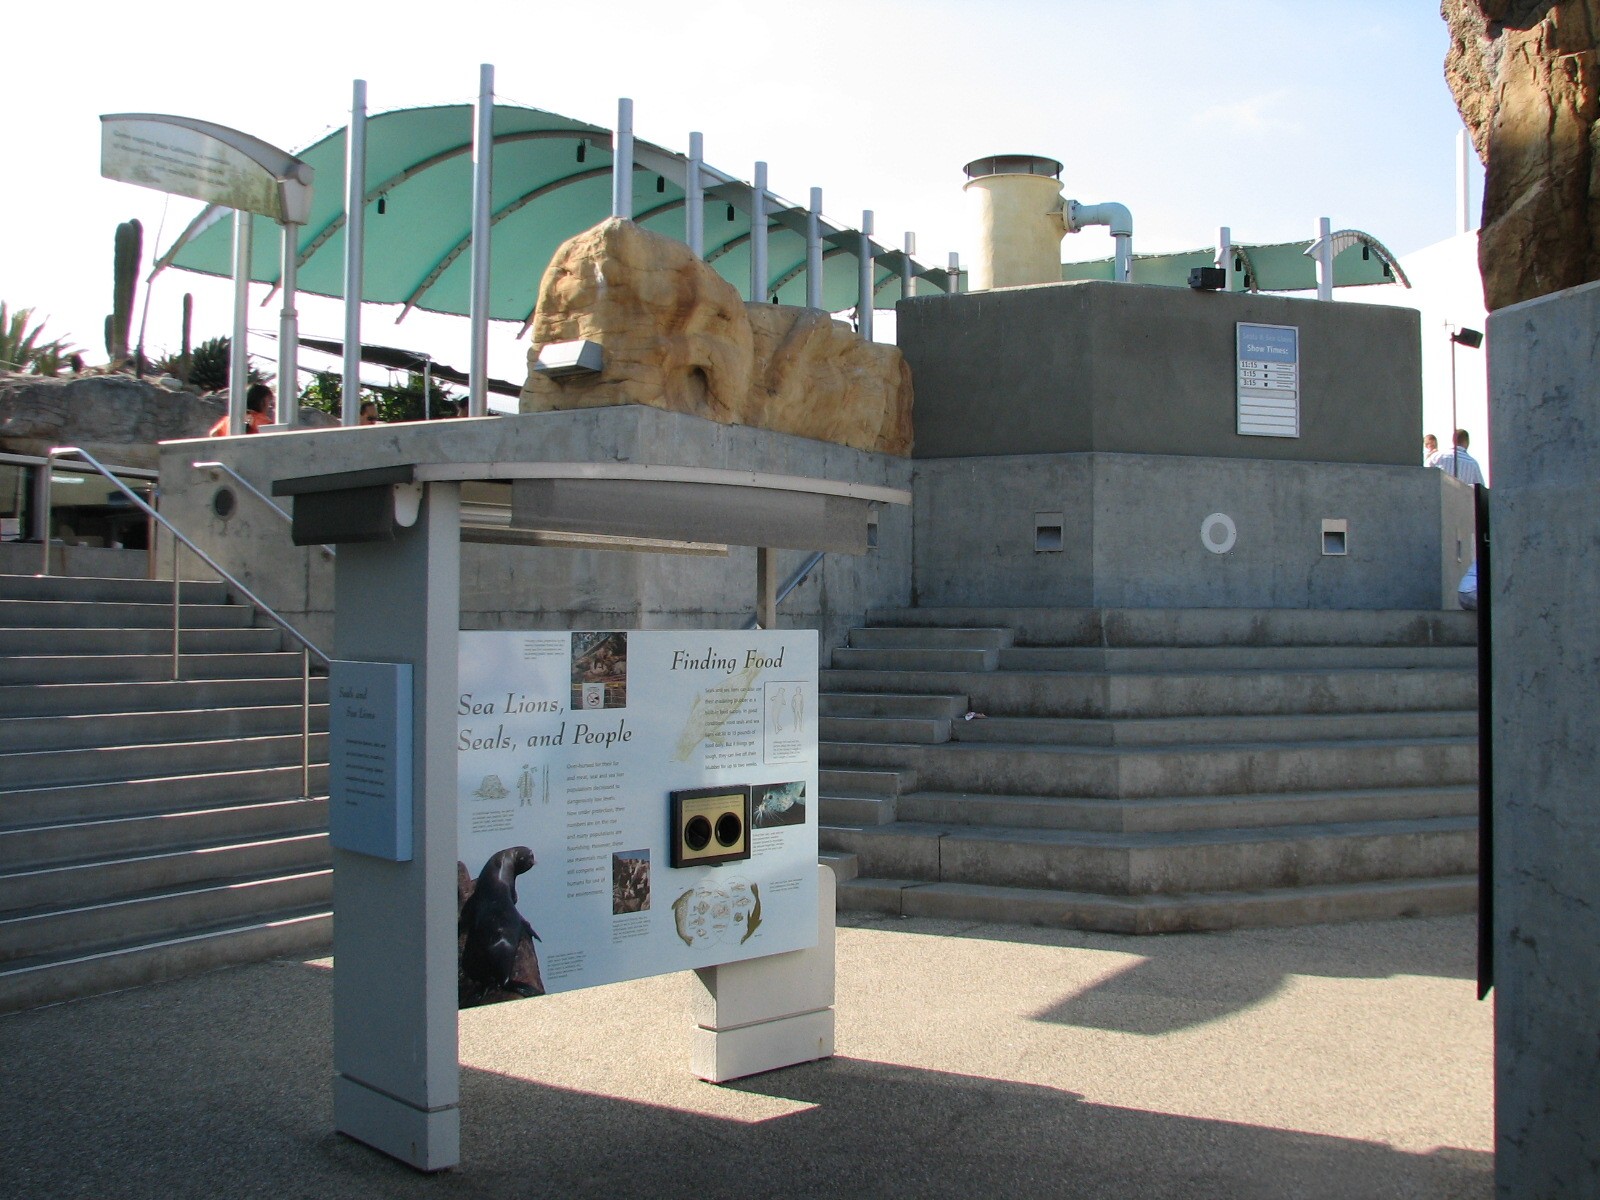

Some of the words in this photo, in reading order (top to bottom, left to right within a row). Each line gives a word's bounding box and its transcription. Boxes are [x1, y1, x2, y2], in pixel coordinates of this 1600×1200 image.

[1247, 344, 1264, 353] Show
[1267, 345, 1288, 355] Times:
[670, 646, 737, 674] Finding
[743, 646, 785, 669] Food
[458, 693, 494, 716] Sea
[504, 692, 564, 715] Lions,
[458, 723, 517, 751] Seals,
[527, 722, 566, 747] and
[572, 718, 632, 749] People
